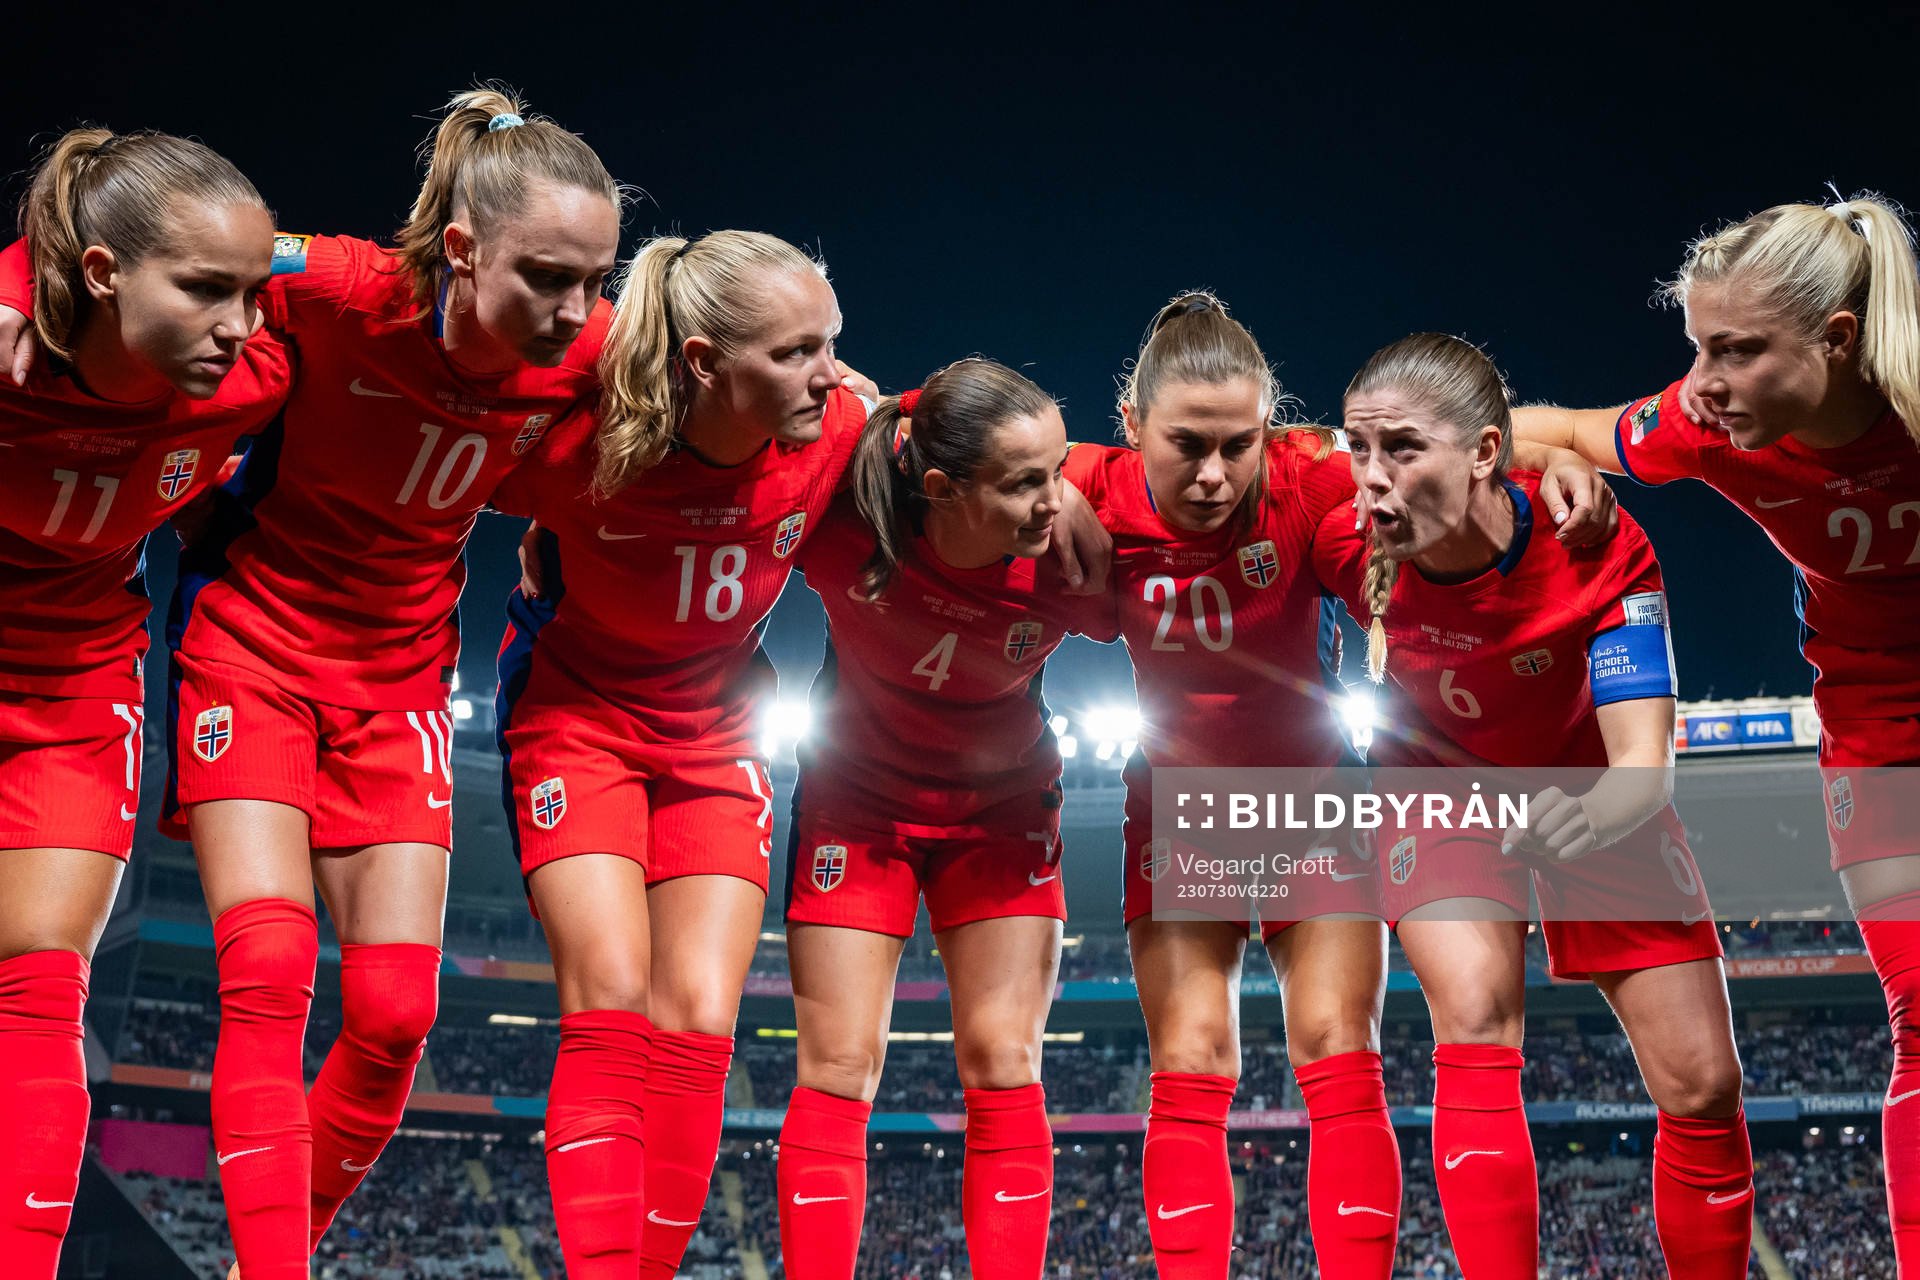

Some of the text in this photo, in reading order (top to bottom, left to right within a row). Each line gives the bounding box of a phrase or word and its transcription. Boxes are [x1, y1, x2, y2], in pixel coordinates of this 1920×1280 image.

[395, 422, 488, 510] 10
[41, 468, 120, 544] 11
[719, 516, 737, 526] 2023
[1827, 501, 1920, 575] 22
[674, 545, 747, 623] 18
[1143, 573, 1234, 653] 20
[1420, 623, 1483, 645] NORGE FILIPPINENE
[1456, 641, 1473, 652] 2023
[1613, 644, 1628, 655] For
[911, 632, 959, 692] 4
[1594, 655, 1630, 670] GENDER
[1595, 664, 1638, 680] EQUALITY
[1439, 669, 1482, 719] 6
[1745, 719, 1785, 737] FIFA
[1659, 830, 1699, 896] 6
[1738, 960, 1797, 975] WORLD
[1801, 957, 1836, 972] CUP
